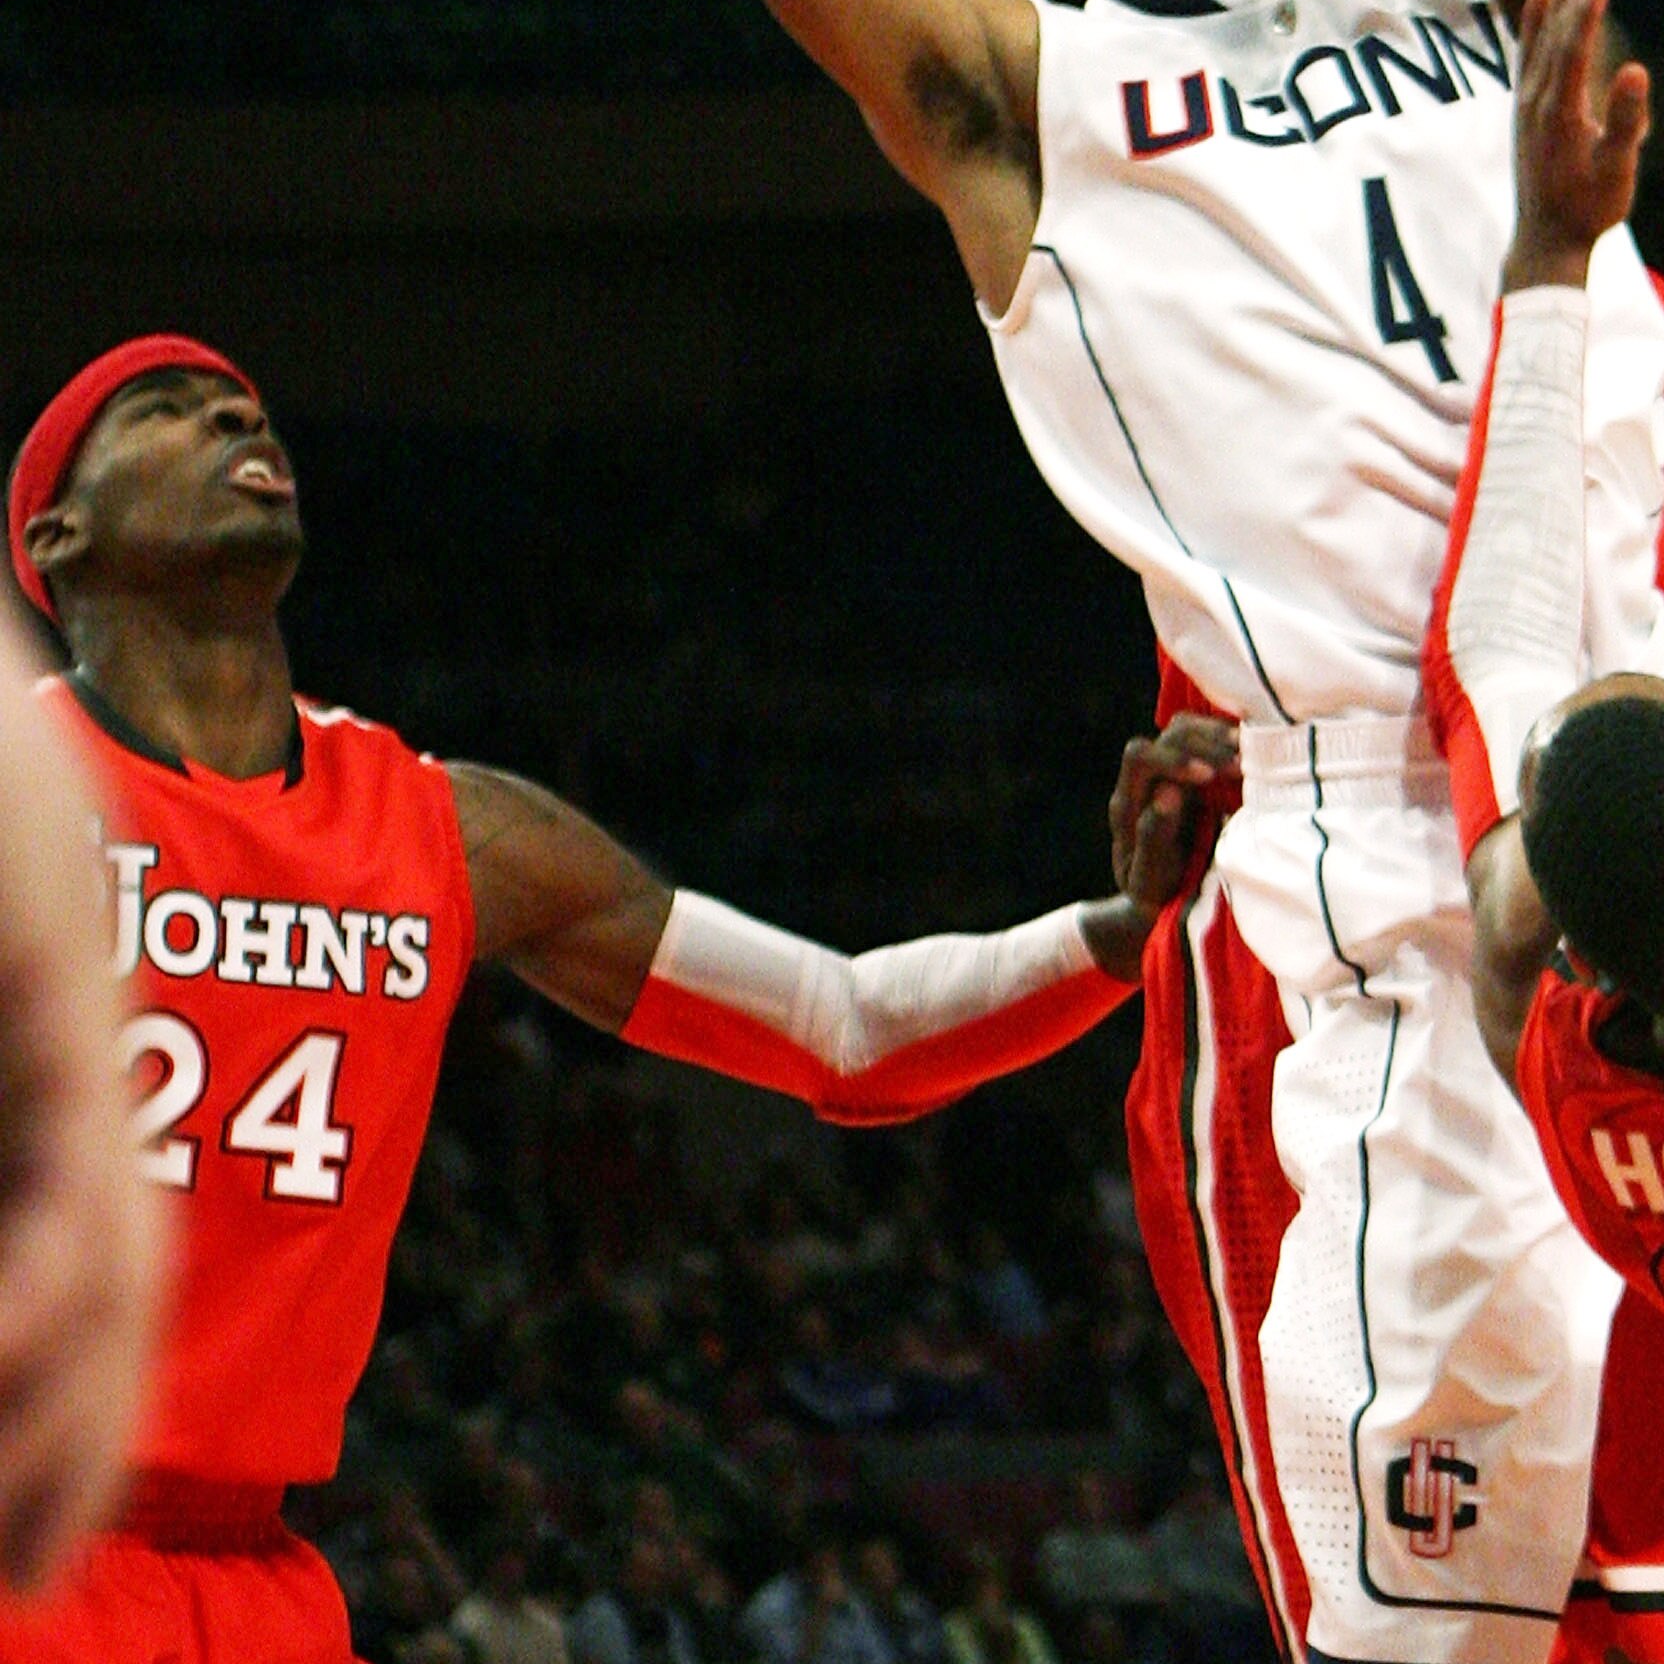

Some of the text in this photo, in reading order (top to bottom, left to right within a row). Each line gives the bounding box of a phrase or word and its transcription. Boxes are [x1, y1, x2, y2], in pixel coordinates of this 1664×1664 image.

[1121, 0, 1516, 161] UCONN
[1363, 176, 1460, 382] 4
[118, 1011, 353, 1207] 24
